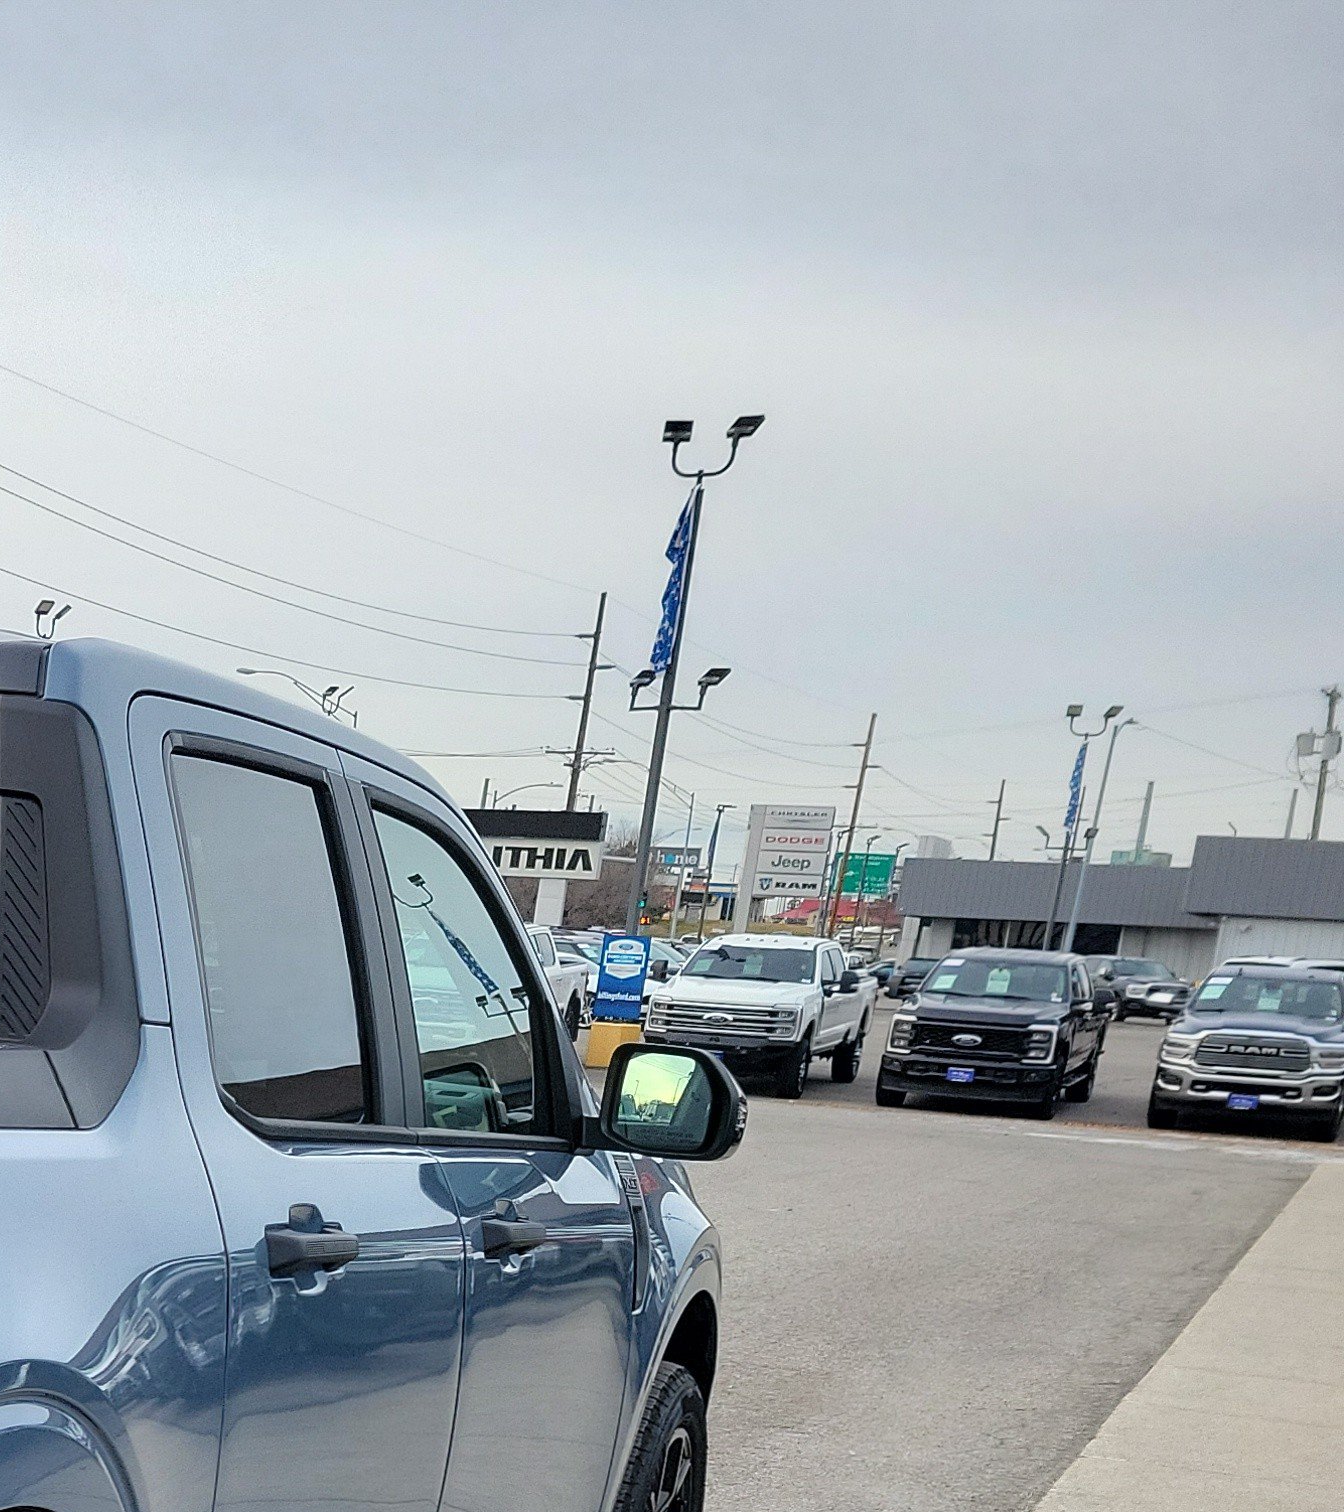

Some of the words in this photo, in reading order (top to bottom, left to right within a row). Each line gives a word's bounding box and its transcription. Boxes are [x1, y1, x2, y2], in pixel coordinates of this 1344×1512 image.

[766, 836, 825, 845] DODGE
[771, 855, 811, 871] Jeep
[1229, 1045, 1278, 1055] RAM
